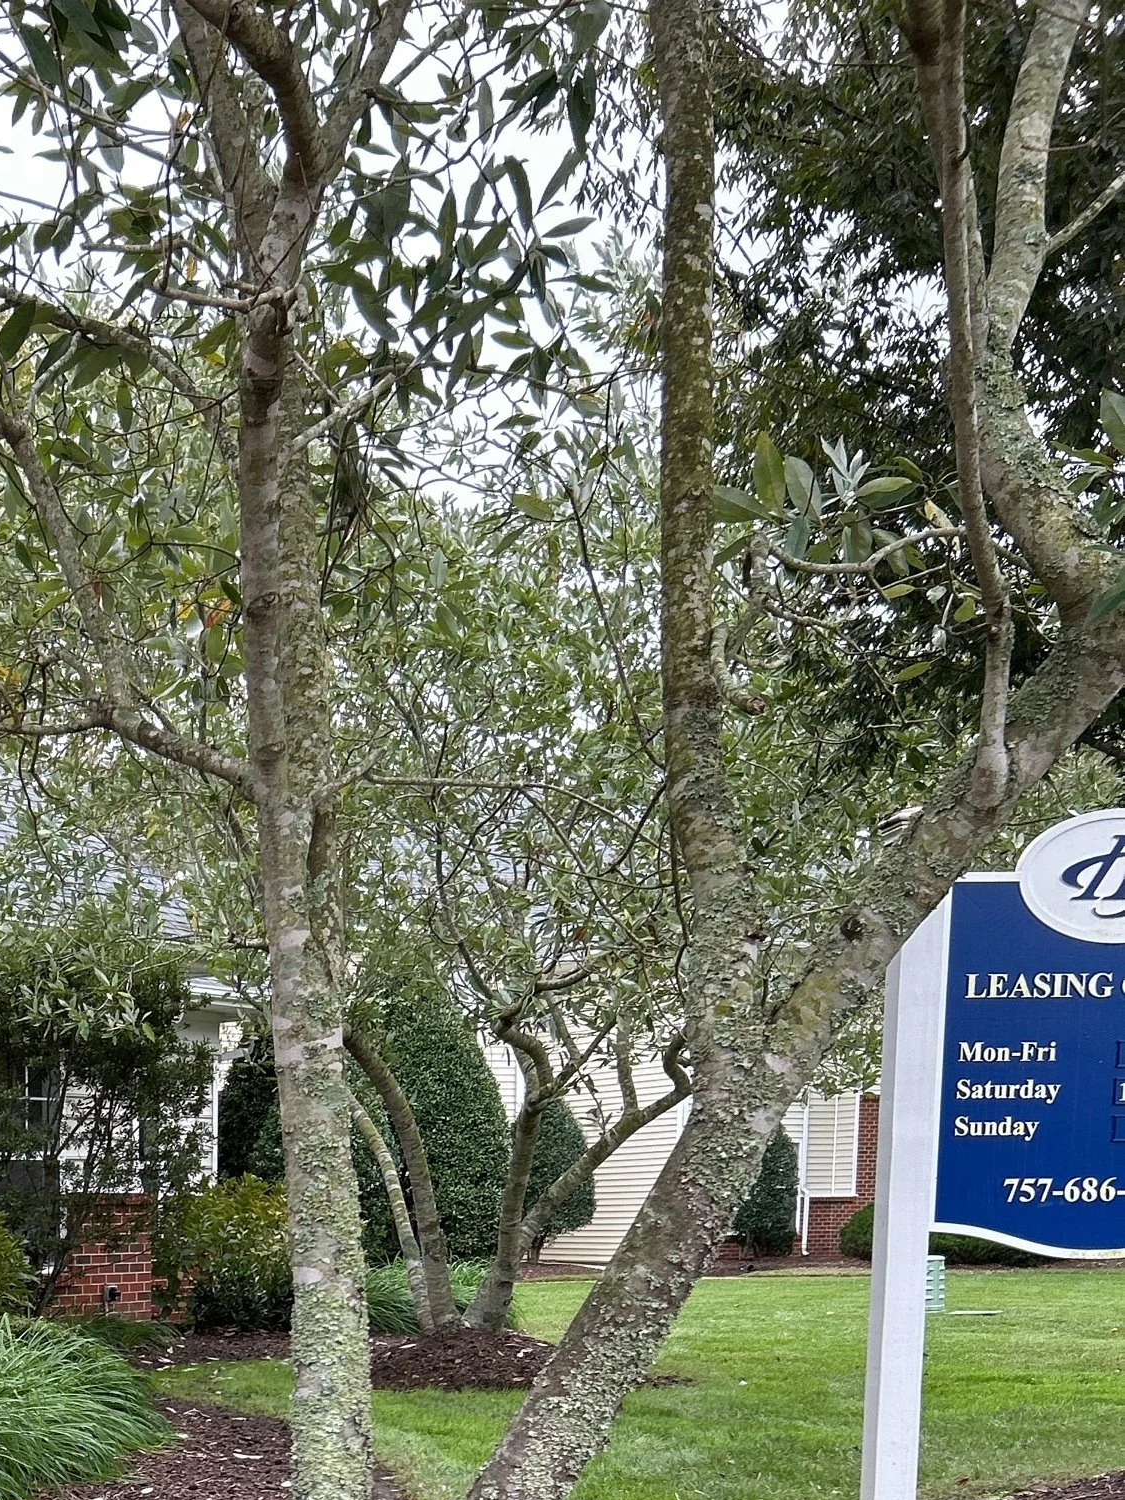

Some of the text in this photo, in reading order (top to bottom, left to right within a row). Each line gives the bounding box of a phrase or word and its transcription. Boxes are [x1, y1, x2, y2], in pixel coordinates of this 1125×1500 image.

[964, 972, 1115, 999] LEASING
[958, 1041, 1057, 1062] Mon-Fri
[956, 1078, 1062, 1105] Saturday
[954, 1115, 1040, 1142] Sunday
